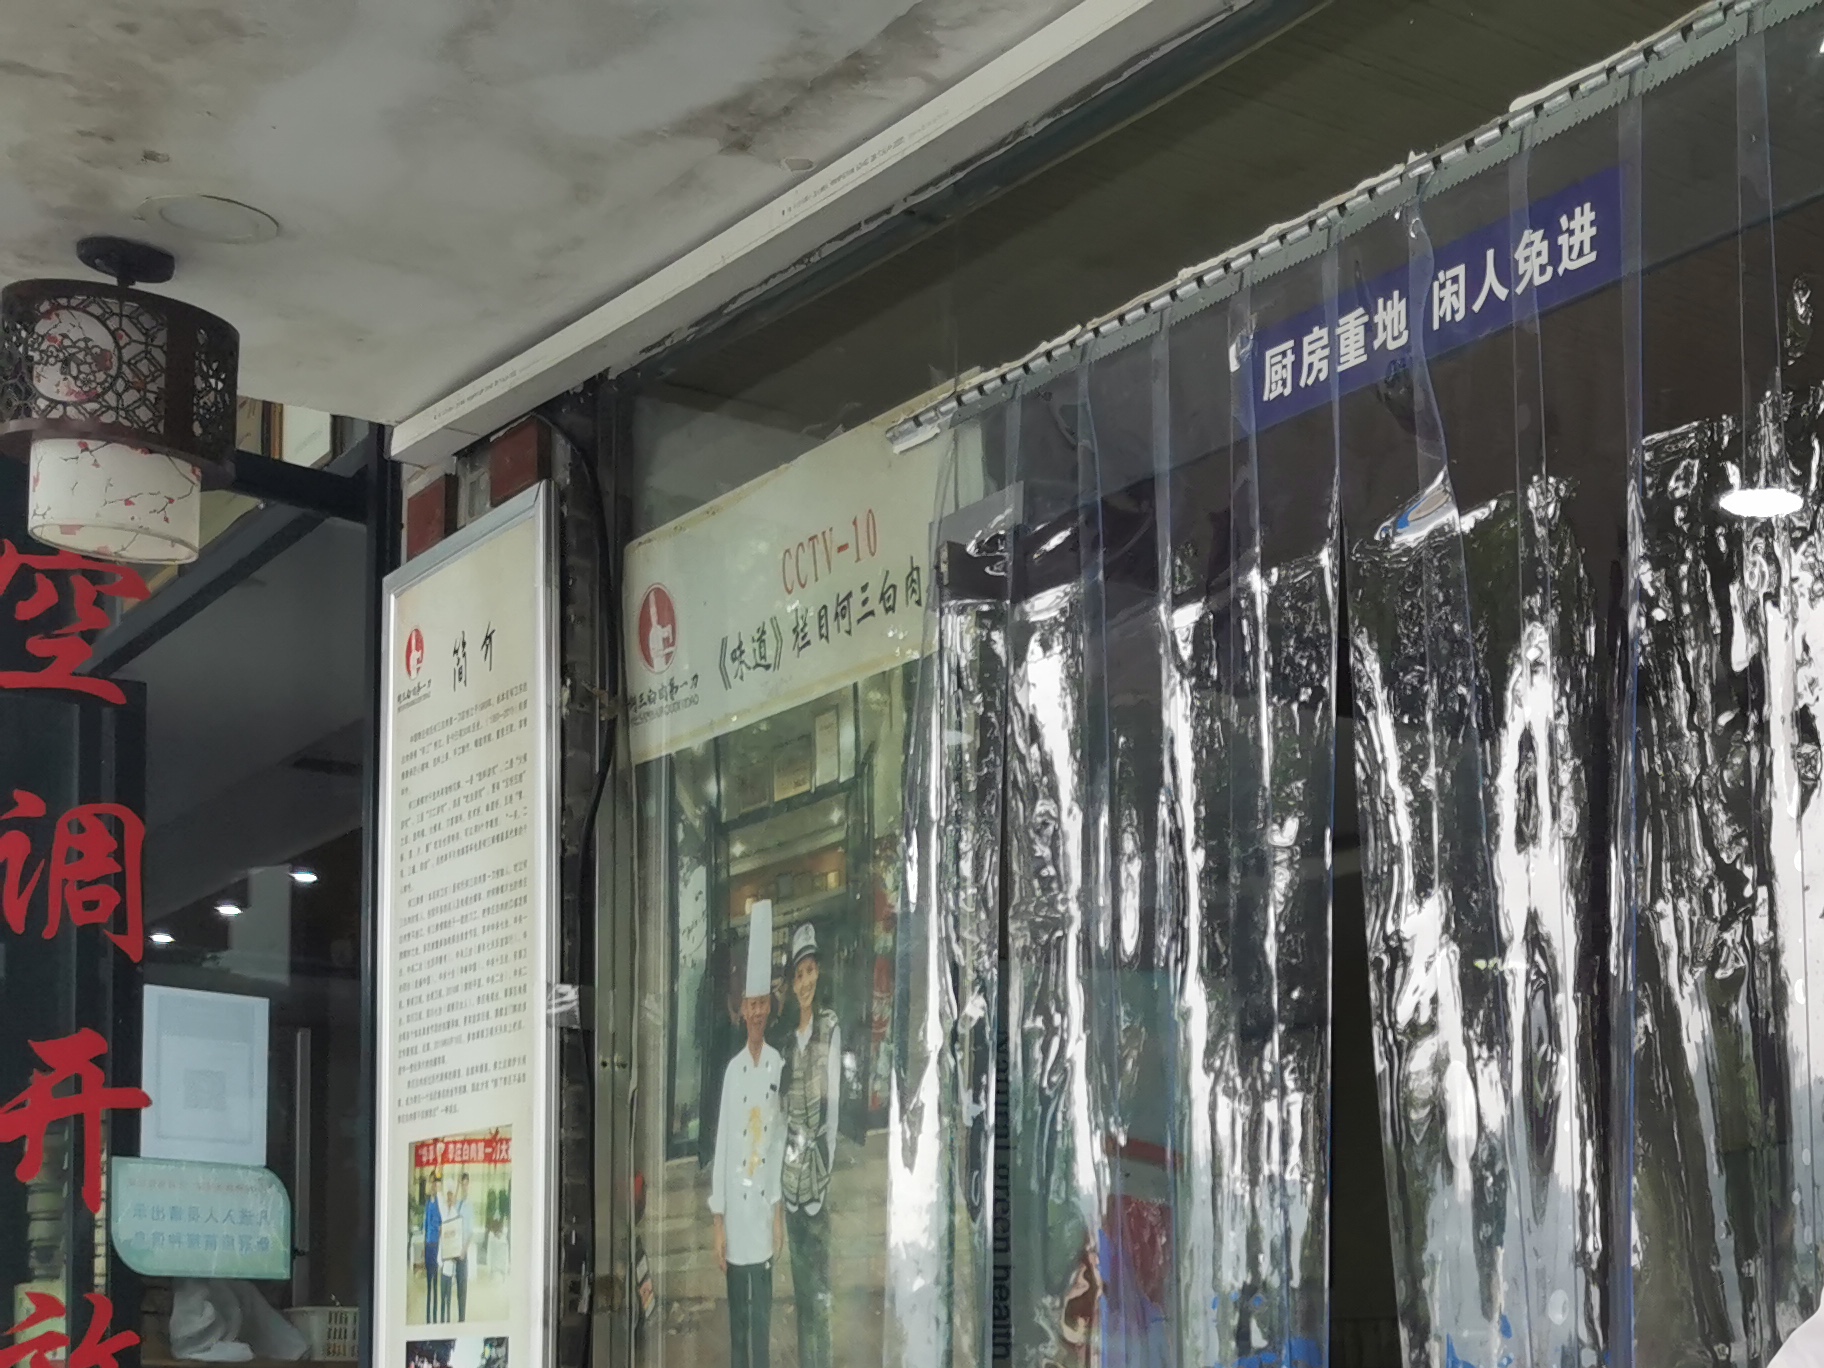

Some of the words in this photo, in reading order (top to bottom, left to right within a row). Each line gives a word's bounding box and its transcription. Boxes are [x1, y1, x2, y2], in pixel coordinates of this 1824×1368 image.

[1262, 290, 1409, 402] 厨房重地
[1431, 202, 1598, 331] 闲人免进
[780, 508, 879, 595] CCTV-10
[451, 621, 496, 692] 简介
[717, 555, 923, 691] 《味道》栏目何三白肉
[991, 1264, 1013, 1361] health
